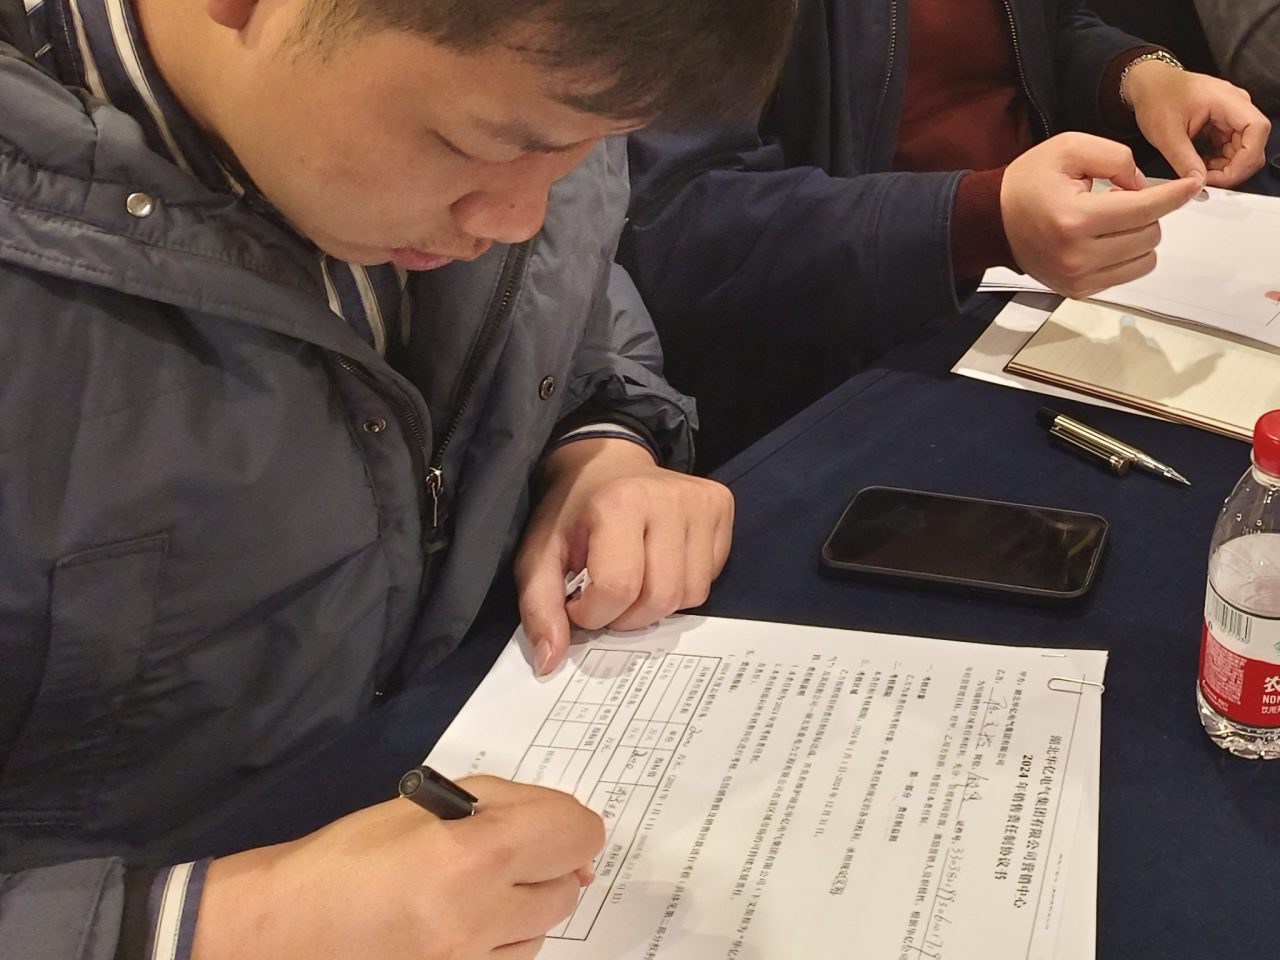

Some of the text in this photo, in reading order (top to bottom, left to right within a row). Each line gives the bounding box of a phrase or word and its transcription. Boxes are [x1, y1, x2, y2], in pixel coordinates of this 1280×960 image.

[1012, 734, 1062, 908] 湖北华亿电气集团有限公司营销中心
